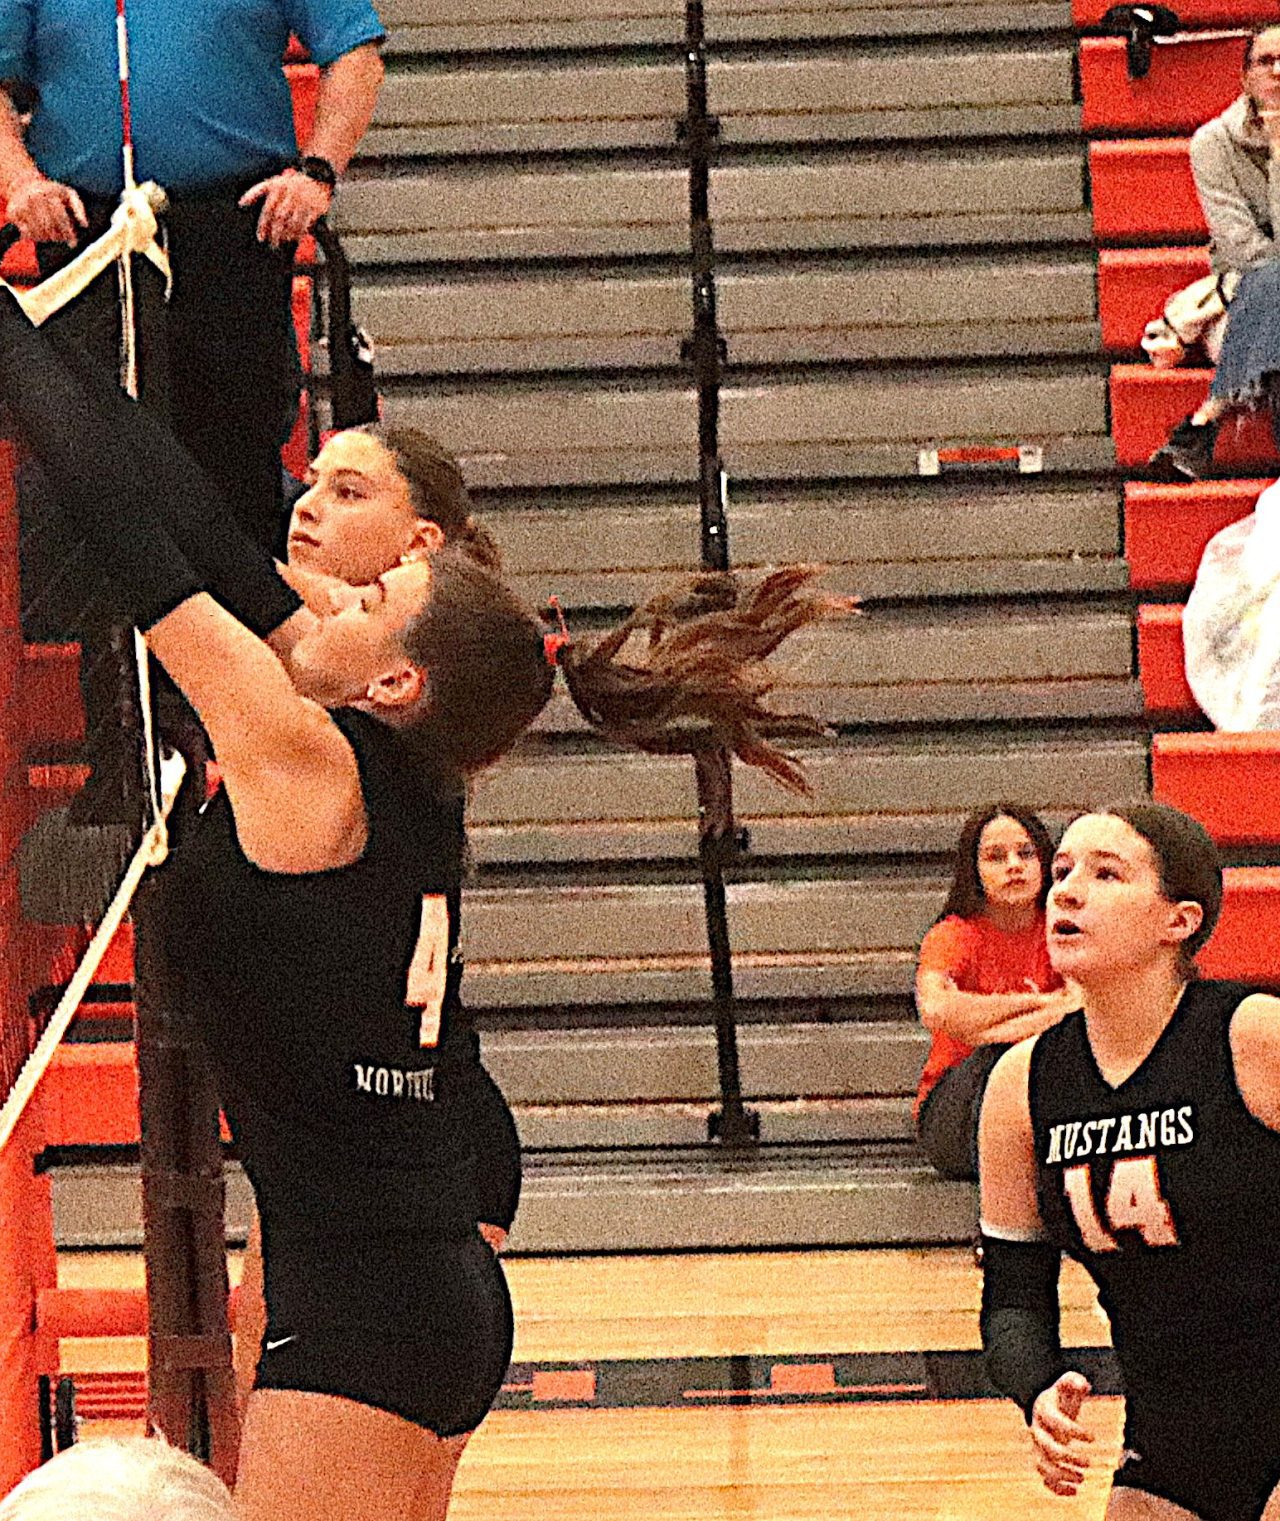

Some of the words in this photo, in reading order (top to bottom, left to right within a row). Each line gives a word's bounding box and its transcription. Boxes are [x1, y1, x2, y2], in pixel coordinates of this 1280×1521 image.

[403, 893, 450, 1048] 4
[1045, 1105, 1194, 1164] MUSTANGS
[1063, 1154, 1181, 1254] 14
